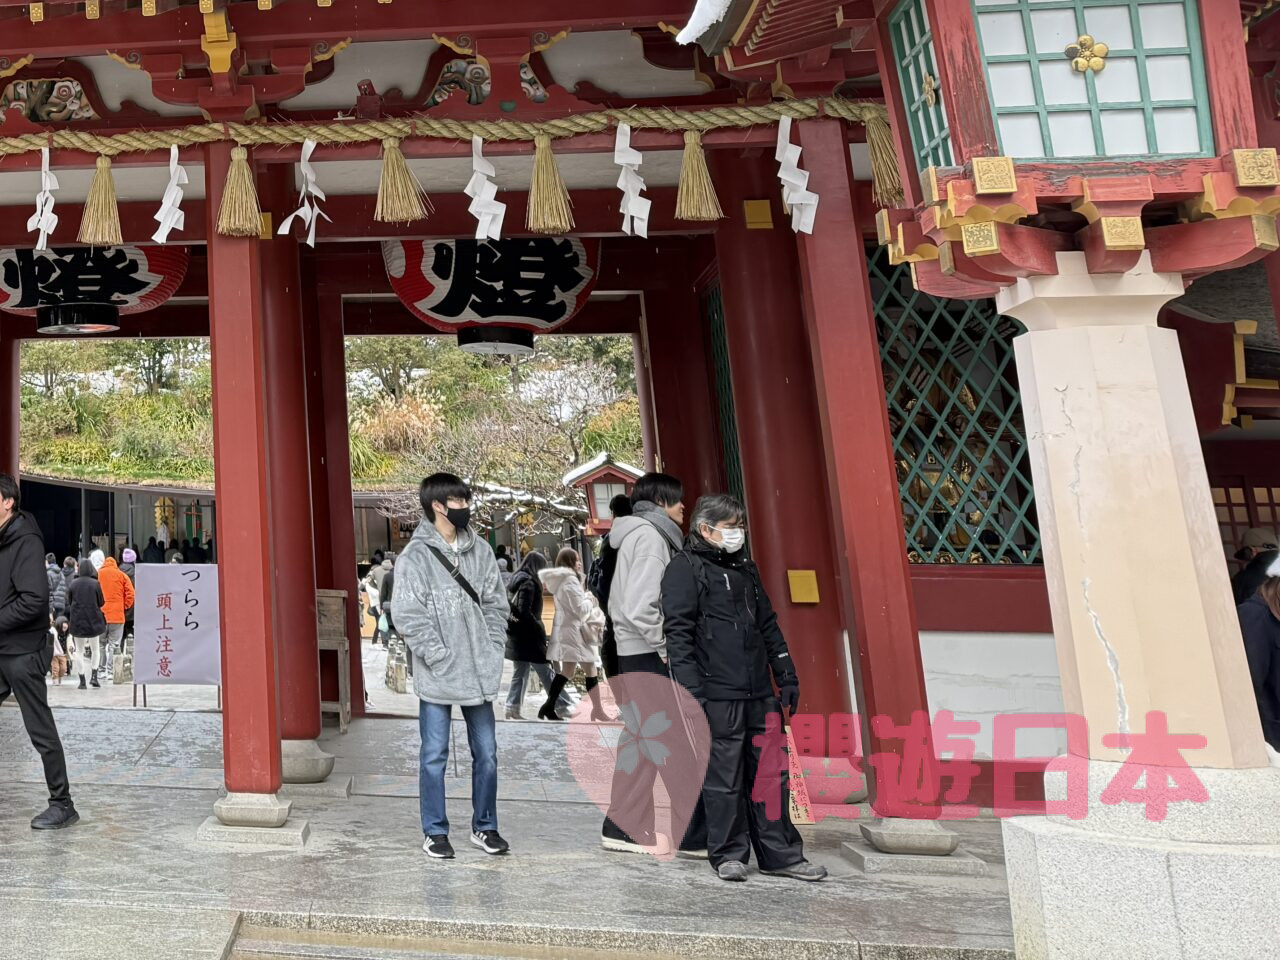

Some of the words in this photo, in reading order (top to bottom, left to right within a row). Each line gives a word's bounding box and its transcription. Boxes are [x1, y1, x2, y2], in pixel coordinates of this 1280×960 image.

[155, 592, 174, 678] 頭上注意
[181, 568, 201, 631] つらら
